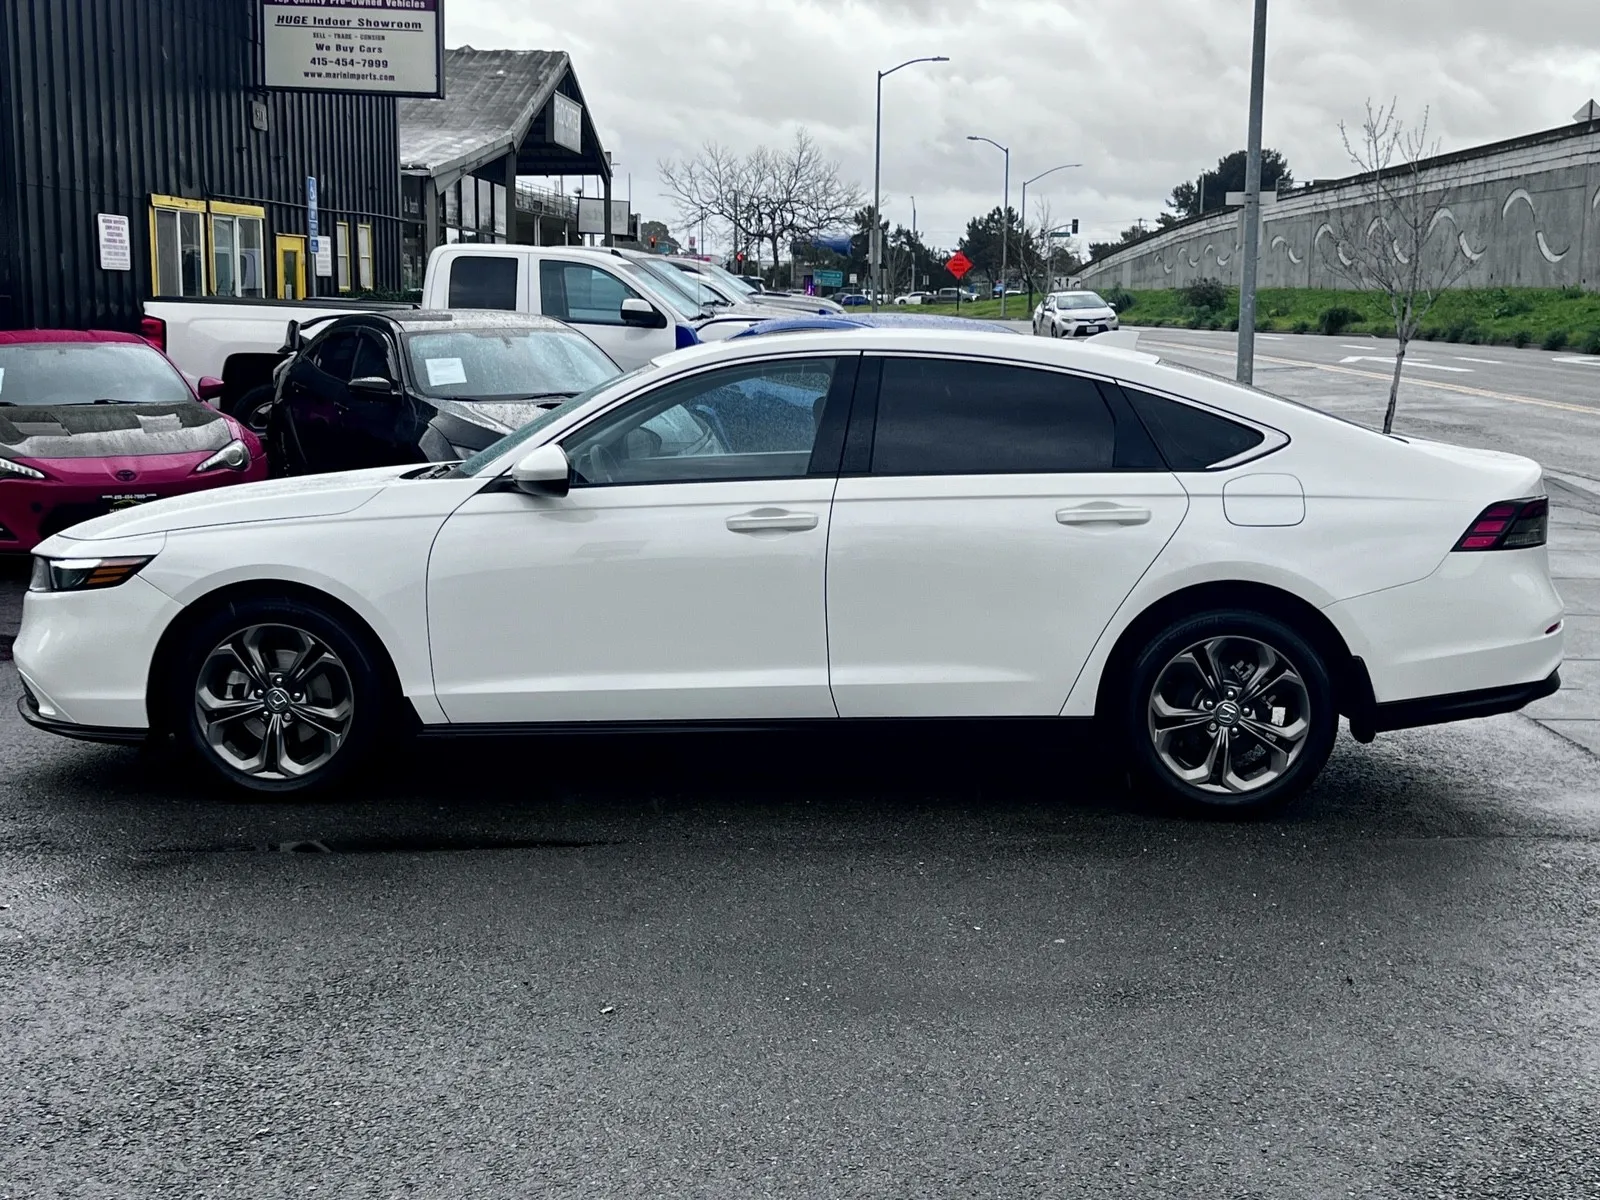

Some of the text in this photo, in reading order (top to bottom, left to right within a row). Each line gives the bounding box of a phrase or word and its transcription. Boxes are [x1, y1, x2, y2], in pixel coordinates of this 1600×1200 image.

[386, 0, 425, 8] Vehicles
[276, 15, 422, 29] HUGE Indoor Showroom
[315, 43, 383, 53] We Buy Cars
[310, 57, 389, 68] 415-454-7999
[303, 71, 396, 81] www.marinimports.com
